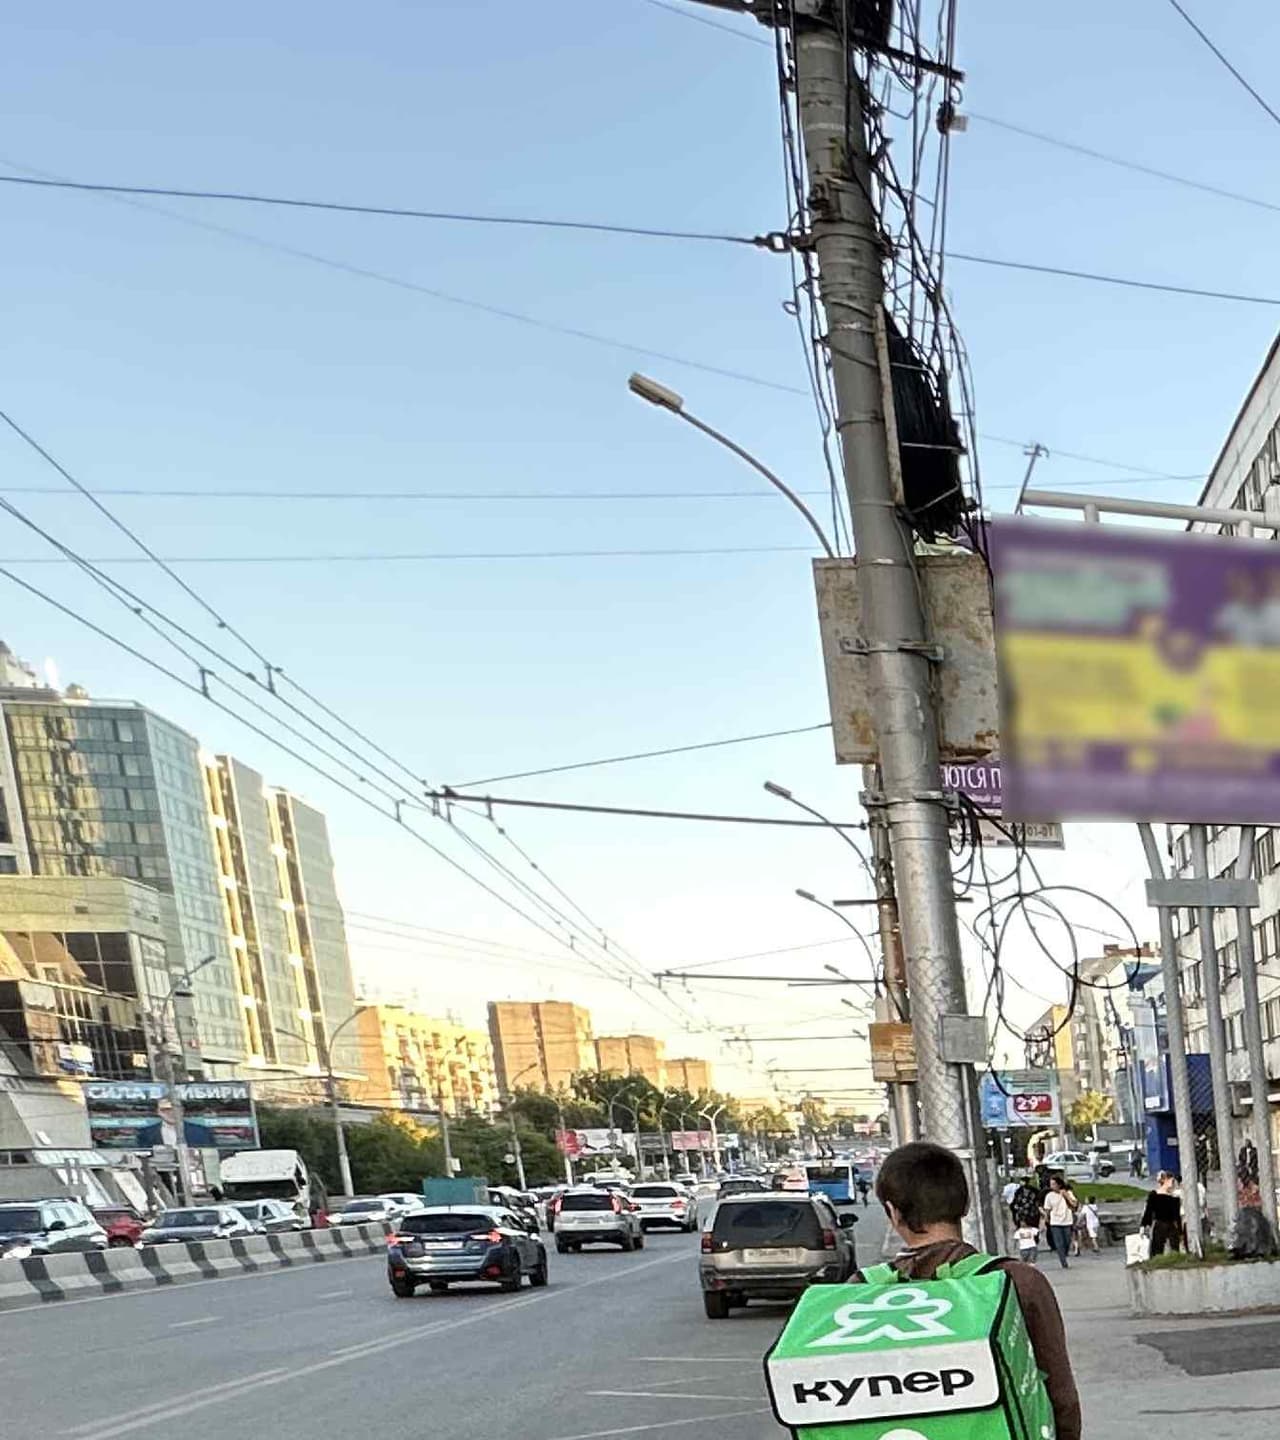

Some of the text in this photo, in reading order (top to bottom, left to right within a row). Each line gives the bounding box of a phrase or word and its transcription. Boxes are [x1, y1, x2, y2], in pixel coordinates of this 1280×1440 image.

[87, 1085, 147, 1100] СИЛА
[175, 1084, 248, 1099] ИБИРИ
[793, 1369, 975, 1407] купер
